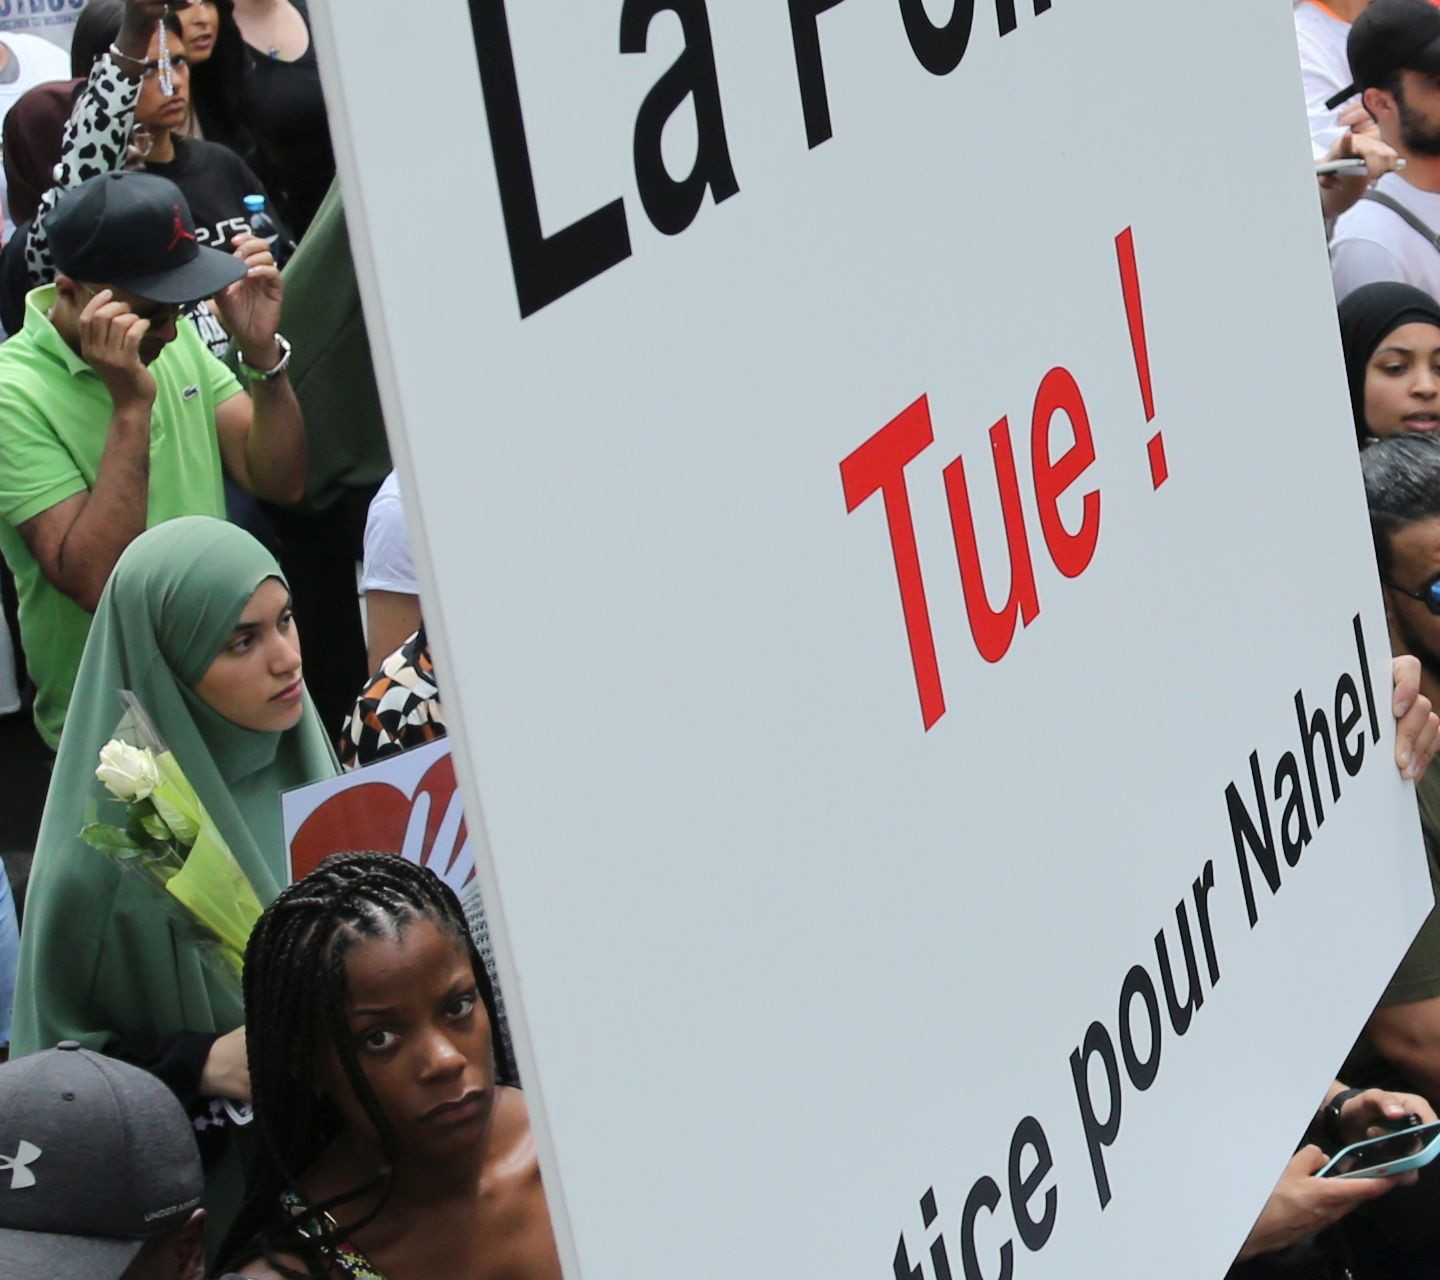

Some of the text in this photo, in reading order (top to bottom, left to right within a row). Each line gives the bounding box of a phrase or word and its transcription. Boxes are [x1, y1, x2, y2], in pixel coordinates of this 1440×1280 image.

[839, 226, 1168, 731] Tue !
[1070, 860, 1220, 1210] pour
[1225, 613, 1380, 929] Nahel
[144, 1206, 176, 1223] UNDER
